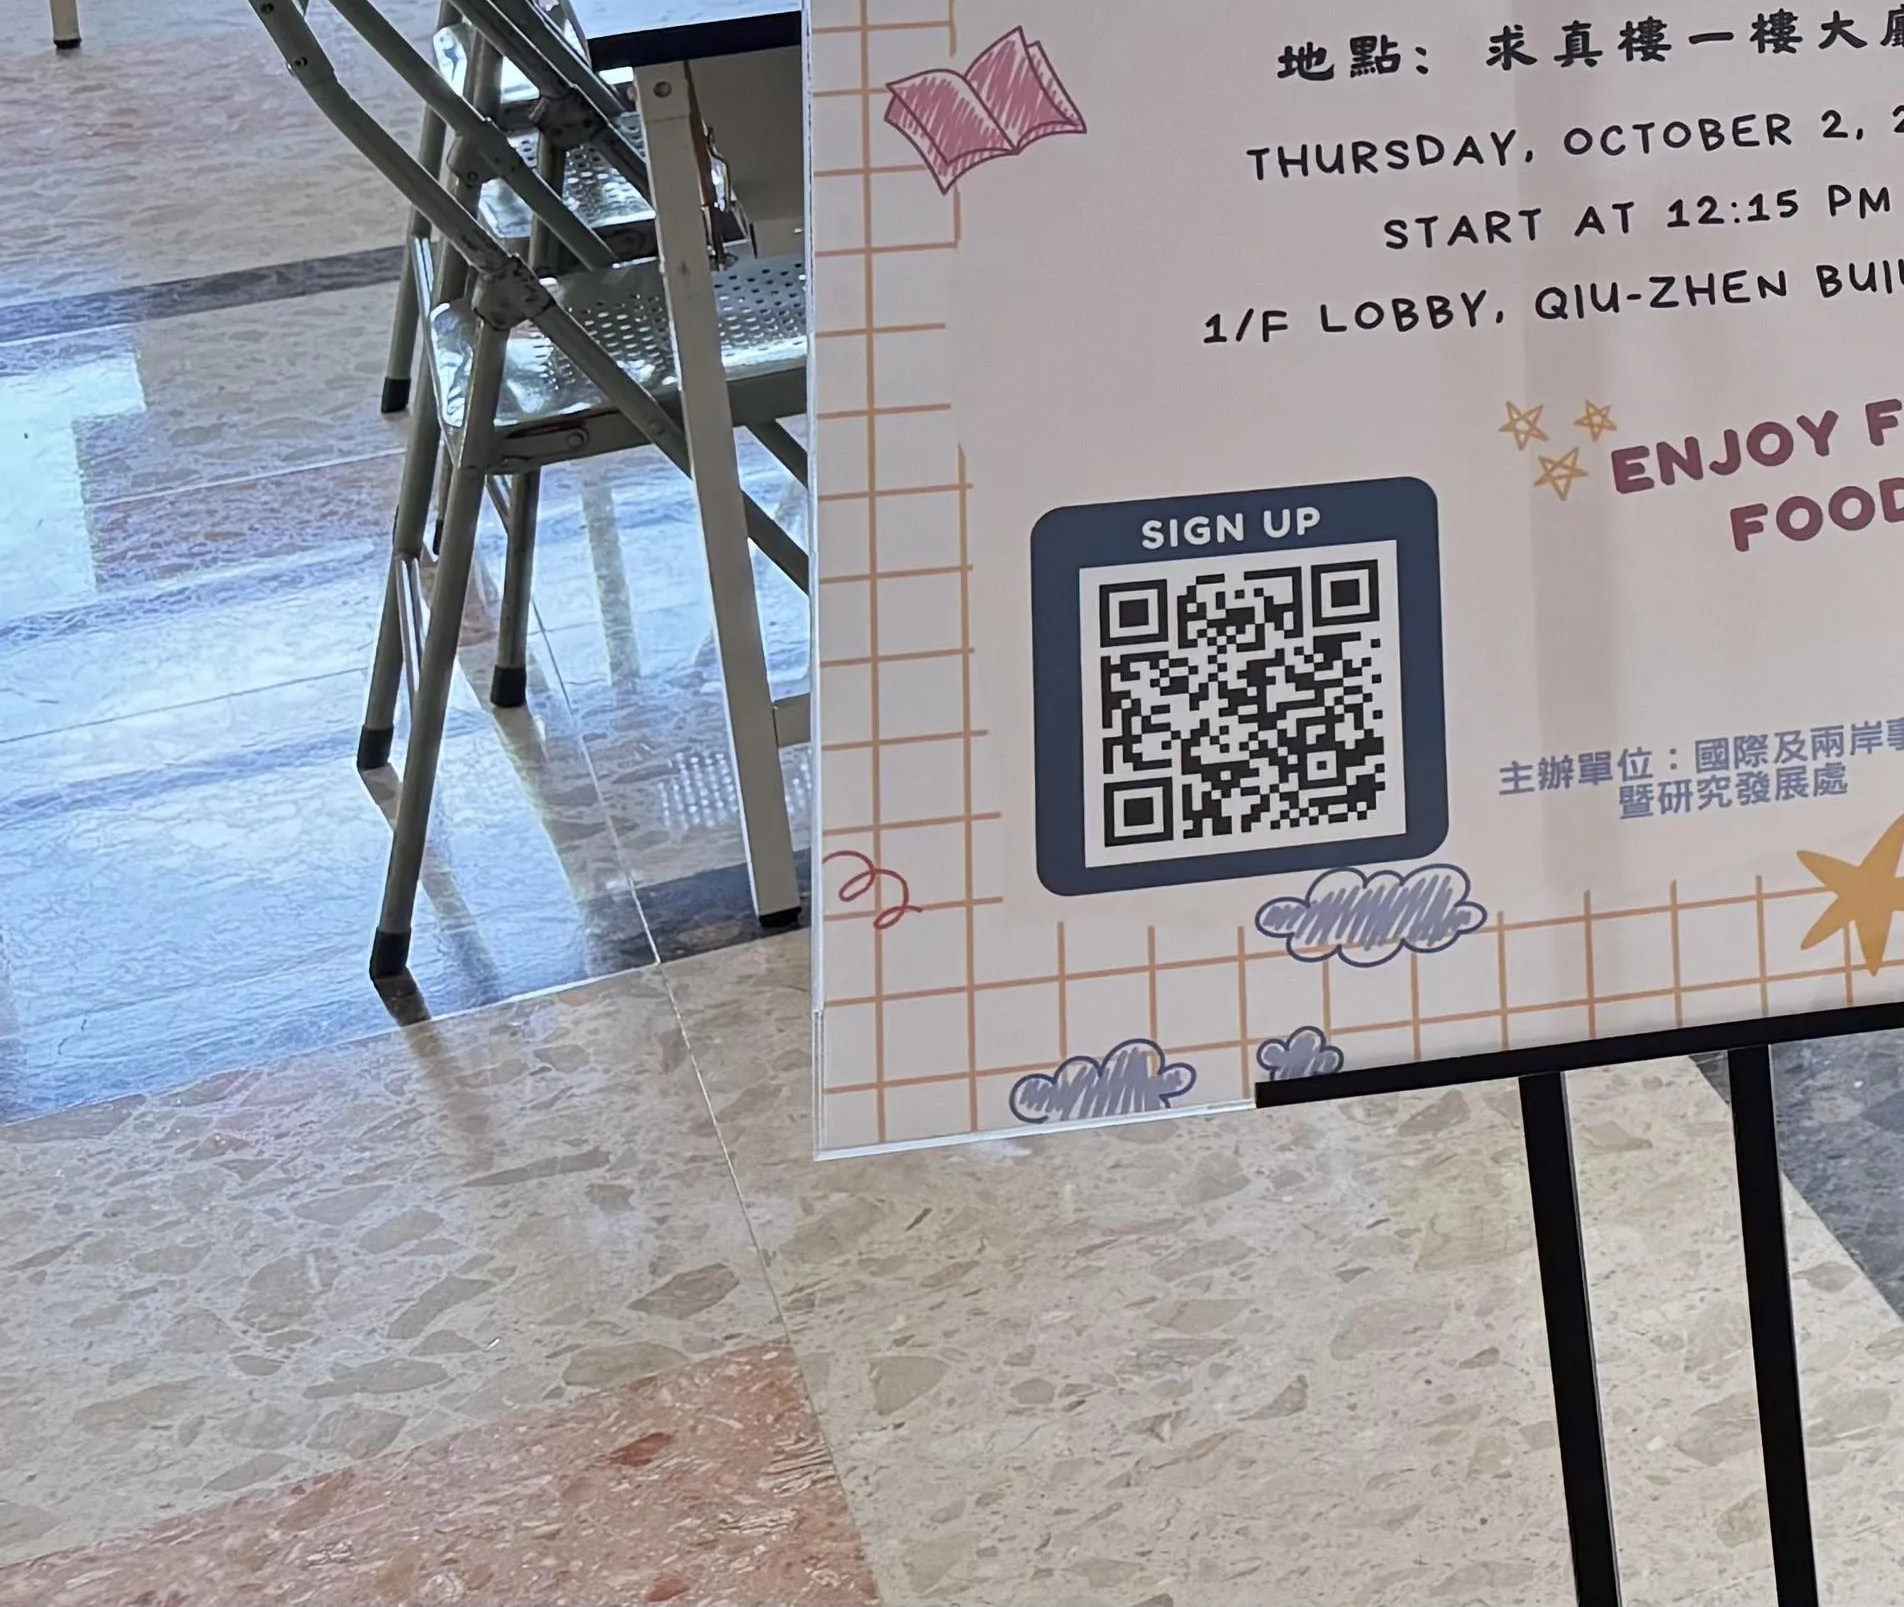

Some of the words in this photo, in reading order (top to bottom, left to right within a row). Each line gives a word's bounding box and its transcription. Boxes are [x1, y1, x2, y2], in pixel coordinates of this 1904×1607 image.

[1247, 130, 1533, 180] THURSDAY,
[1564, 114, 1791, 156] OCTOBER
[1822, 110, 1863, 140] 2,
[1384, 208, 1541, 249] START
[1575, 202, 1634, 236] AT
[1667, 189, 1798, 227] 12:15
[1828, 185, 1890, 219] PM
[1204, 309, 1287, 343] 1/F
[1321, 290, 1503, 332] LOBBY,
[1535, 270, 1786, 319] QIU-ZHEN
[1611, 411, 1842, 495] ENJOY
[1142, 514, 1246, 550] SIGN
[1264, 506, 1321, 540] UP
[1617, 762, 1848, 820] 暨研究發展處
